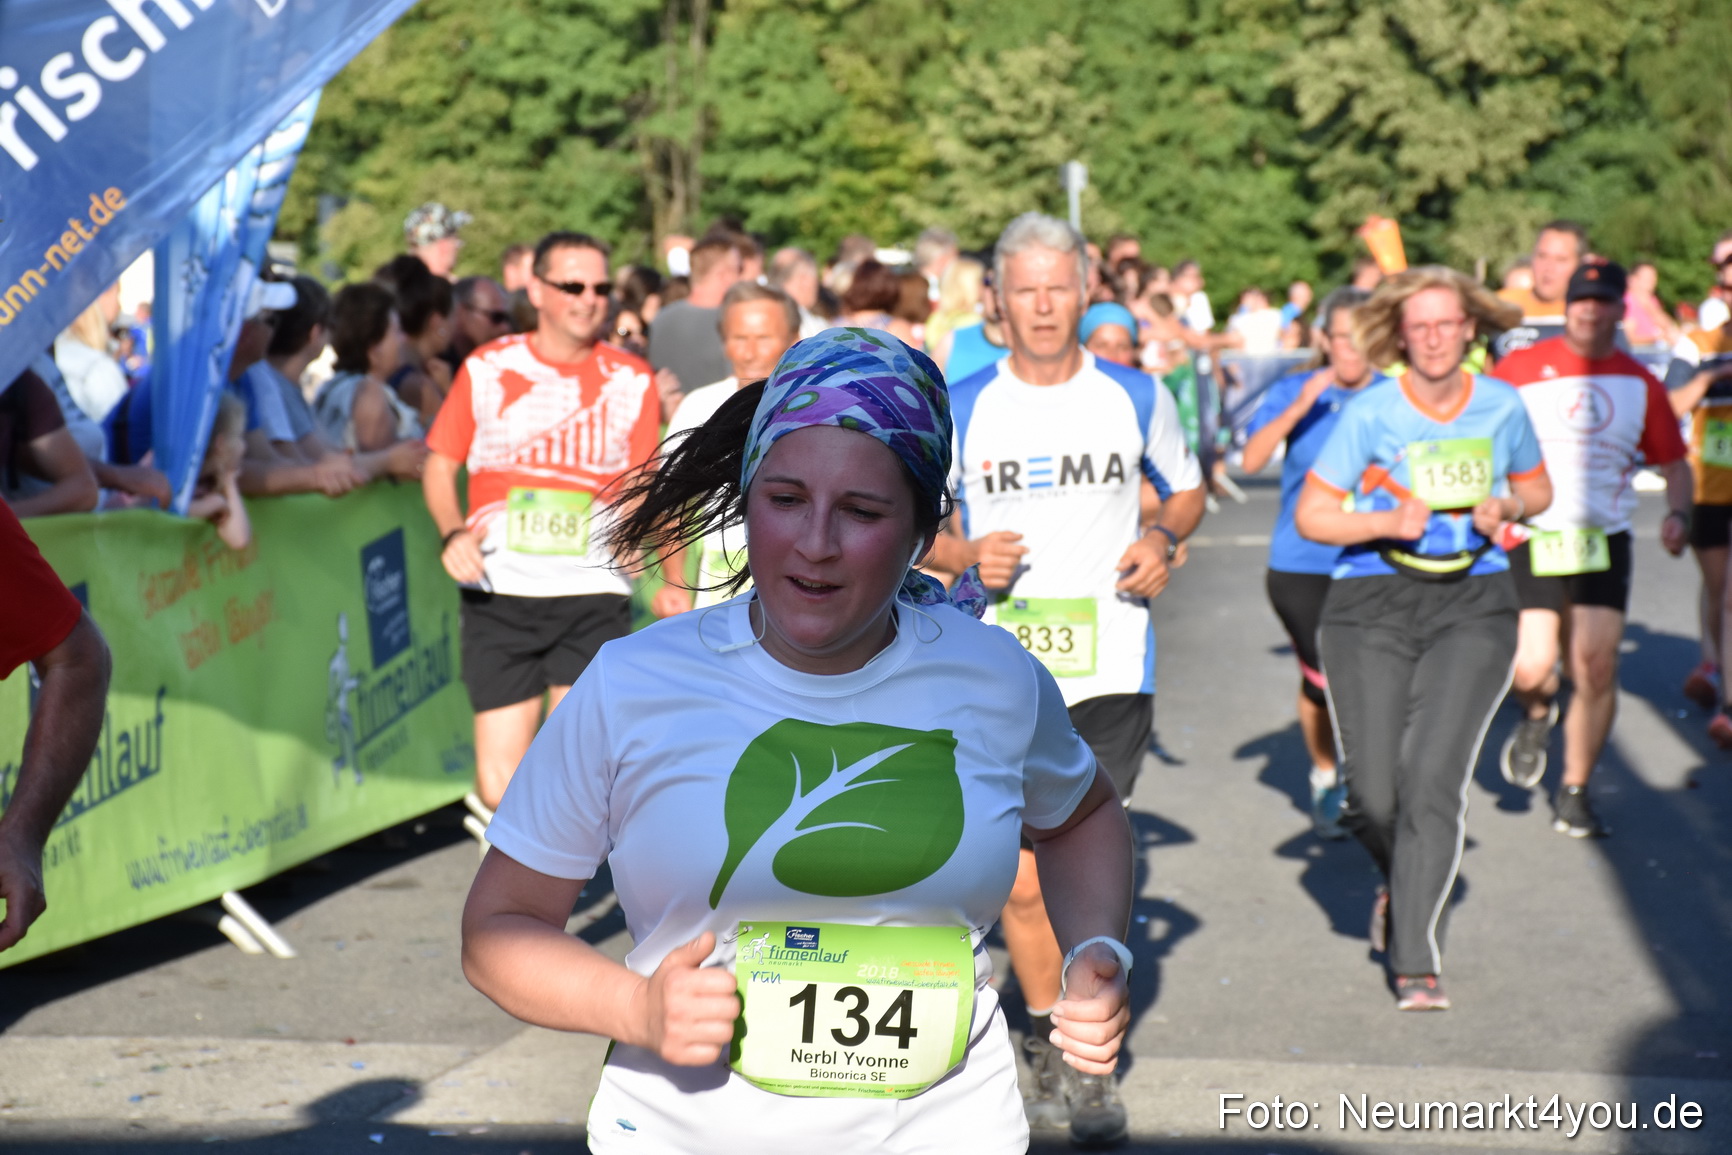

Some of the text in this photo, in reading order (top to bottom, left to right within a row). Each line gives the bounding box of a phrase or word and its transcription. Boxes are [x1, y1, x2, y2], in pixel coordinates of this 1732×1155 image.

[0, 0, 217, 171] risch
[1426, 459, 1487, 488] 1583
[519, 511, 578, 538] 1868
[1018, 625, 1074, 653] 833
[768, 945, 849, 963] firmenlauf
[857, 964, 899, 979] 2018
[789, 983, 918, 1050] 134
[791, 1048, 909, 1069] Nerbl Yvonne
[810, 1068, 886, 1082] Bionorica SE
